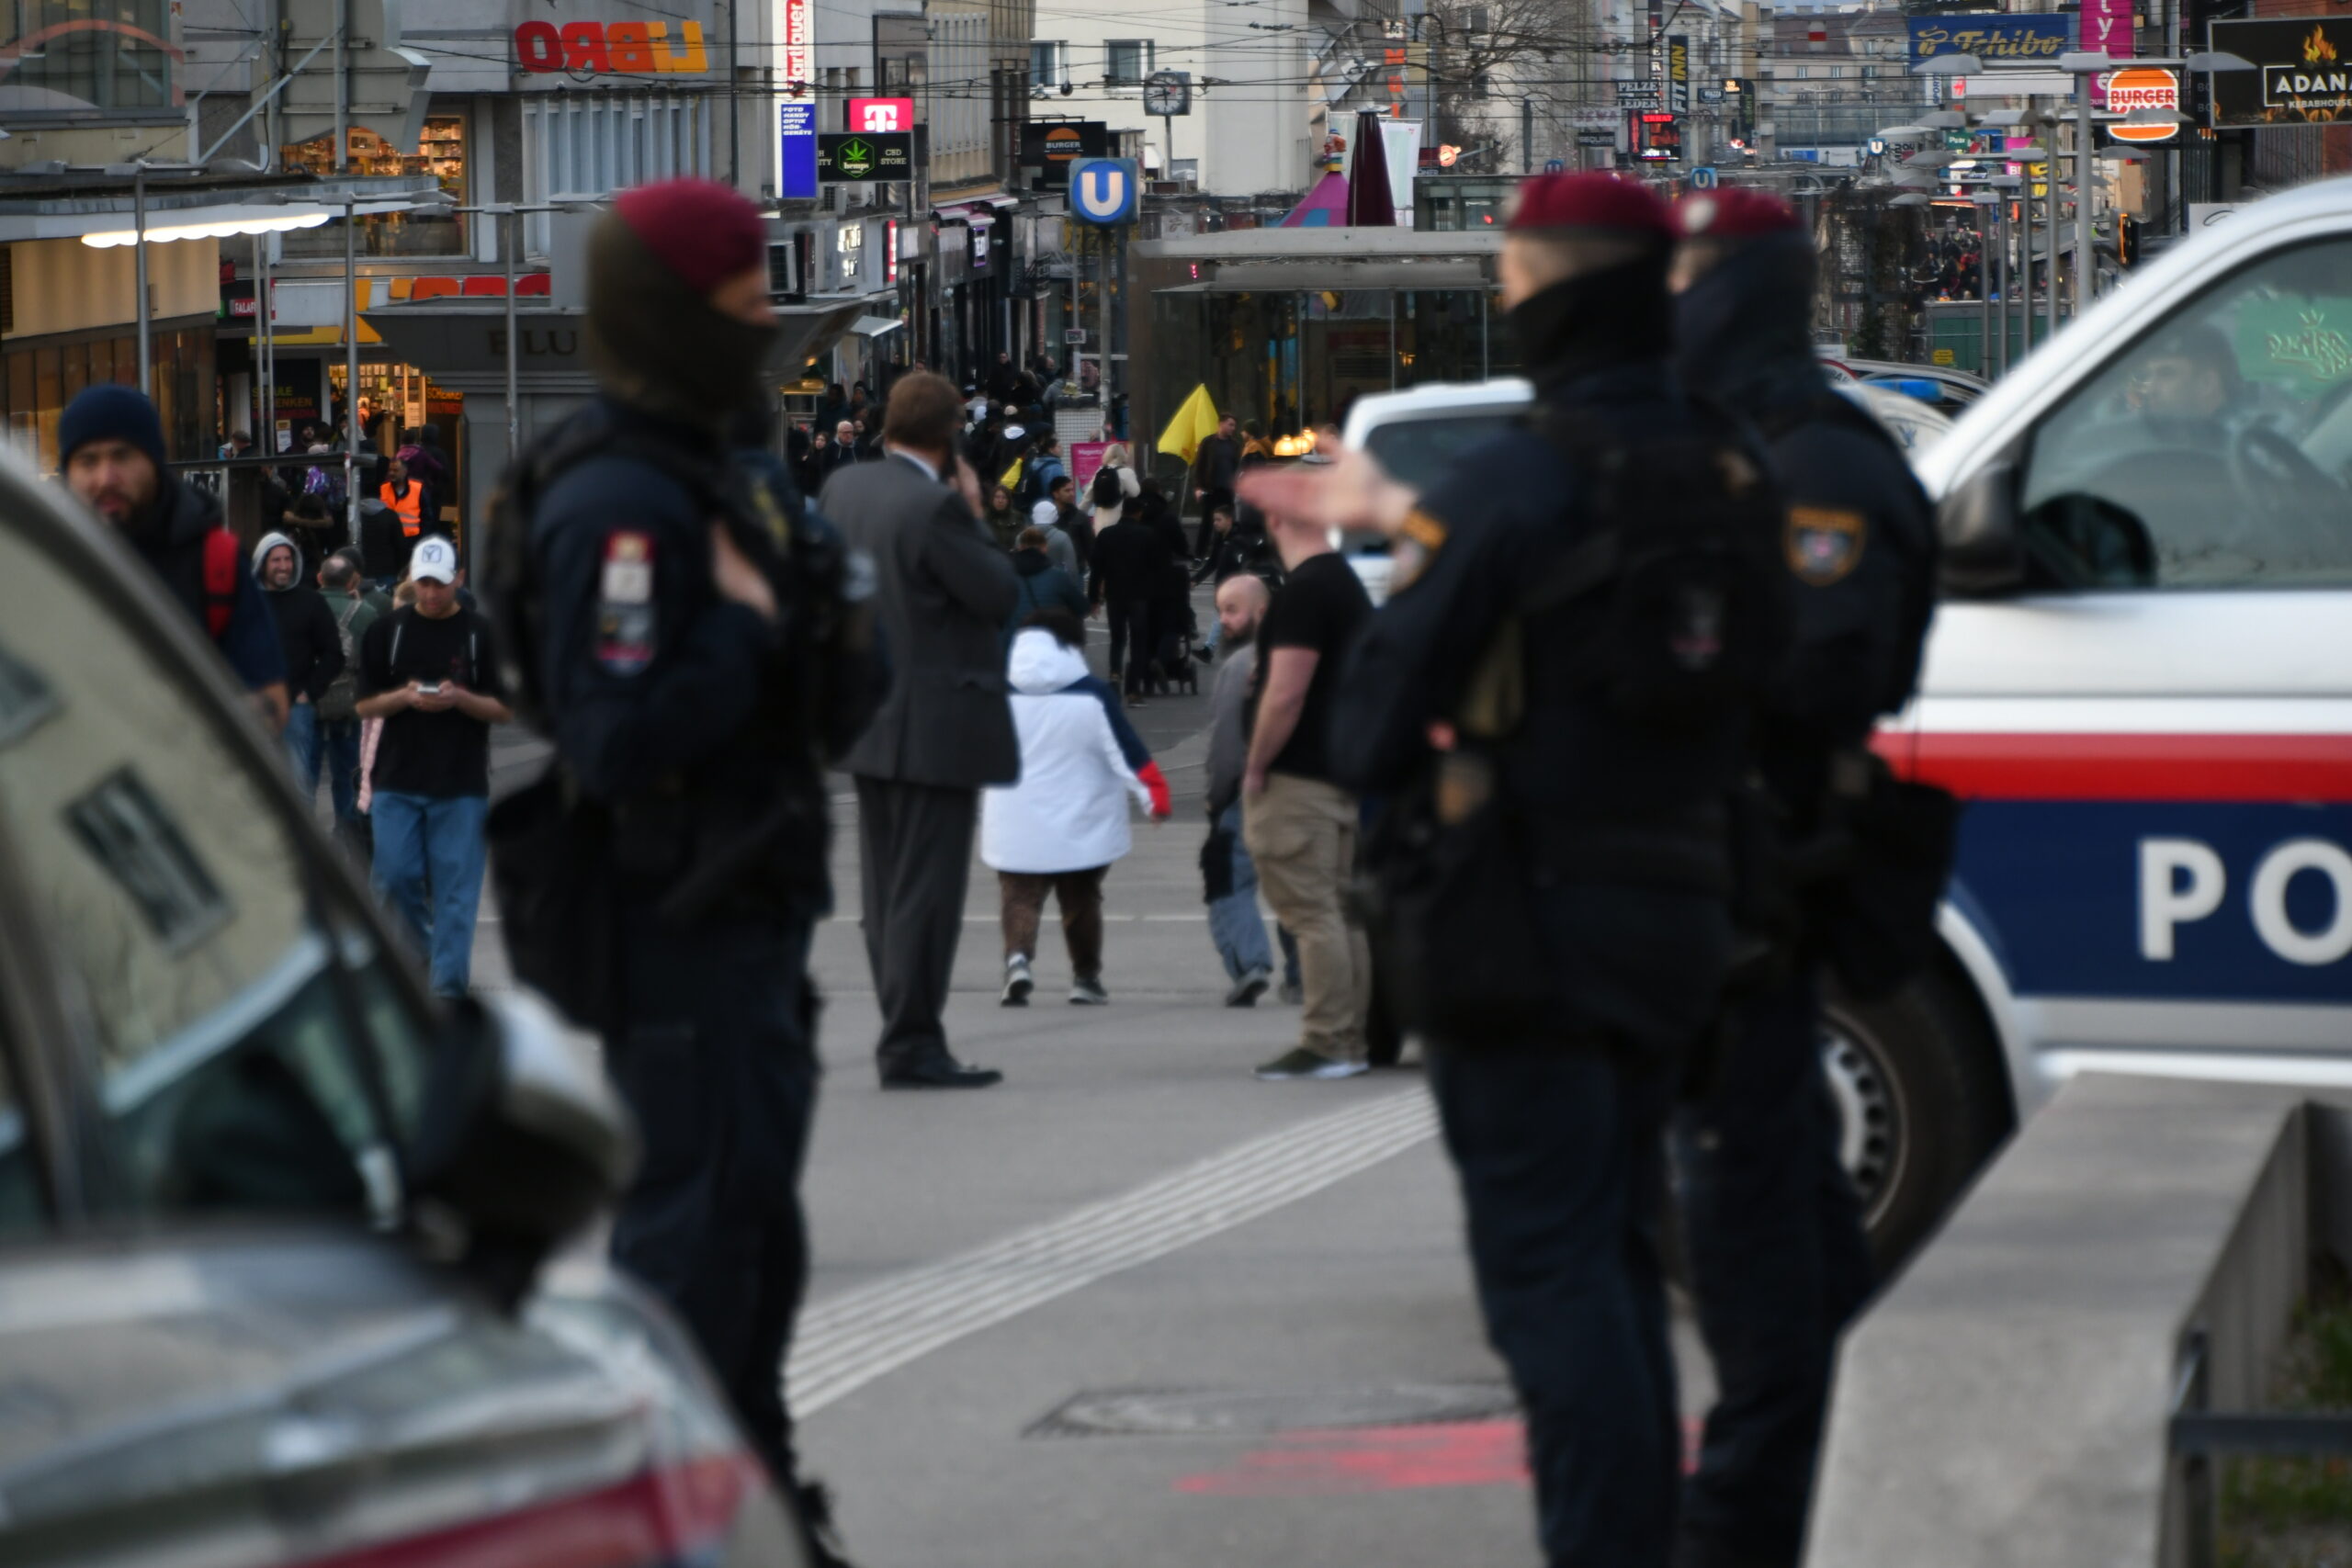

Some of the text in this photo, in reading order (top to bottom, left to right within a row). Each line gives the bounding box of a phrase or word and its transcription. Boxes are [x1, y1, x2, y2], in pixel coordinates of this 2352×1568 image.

[1671, 44, 1687, 113] FIT INN
[1618, 81, 1658, 92] PELZE
[2110, 89, 2177, 105] BURGER
[1618, 98, 1659, 108] LEDER
[843, 162, 869, 171] hemps
[880, 157, 907, 165] STORE
[1081, 172, 1124, 217] U
